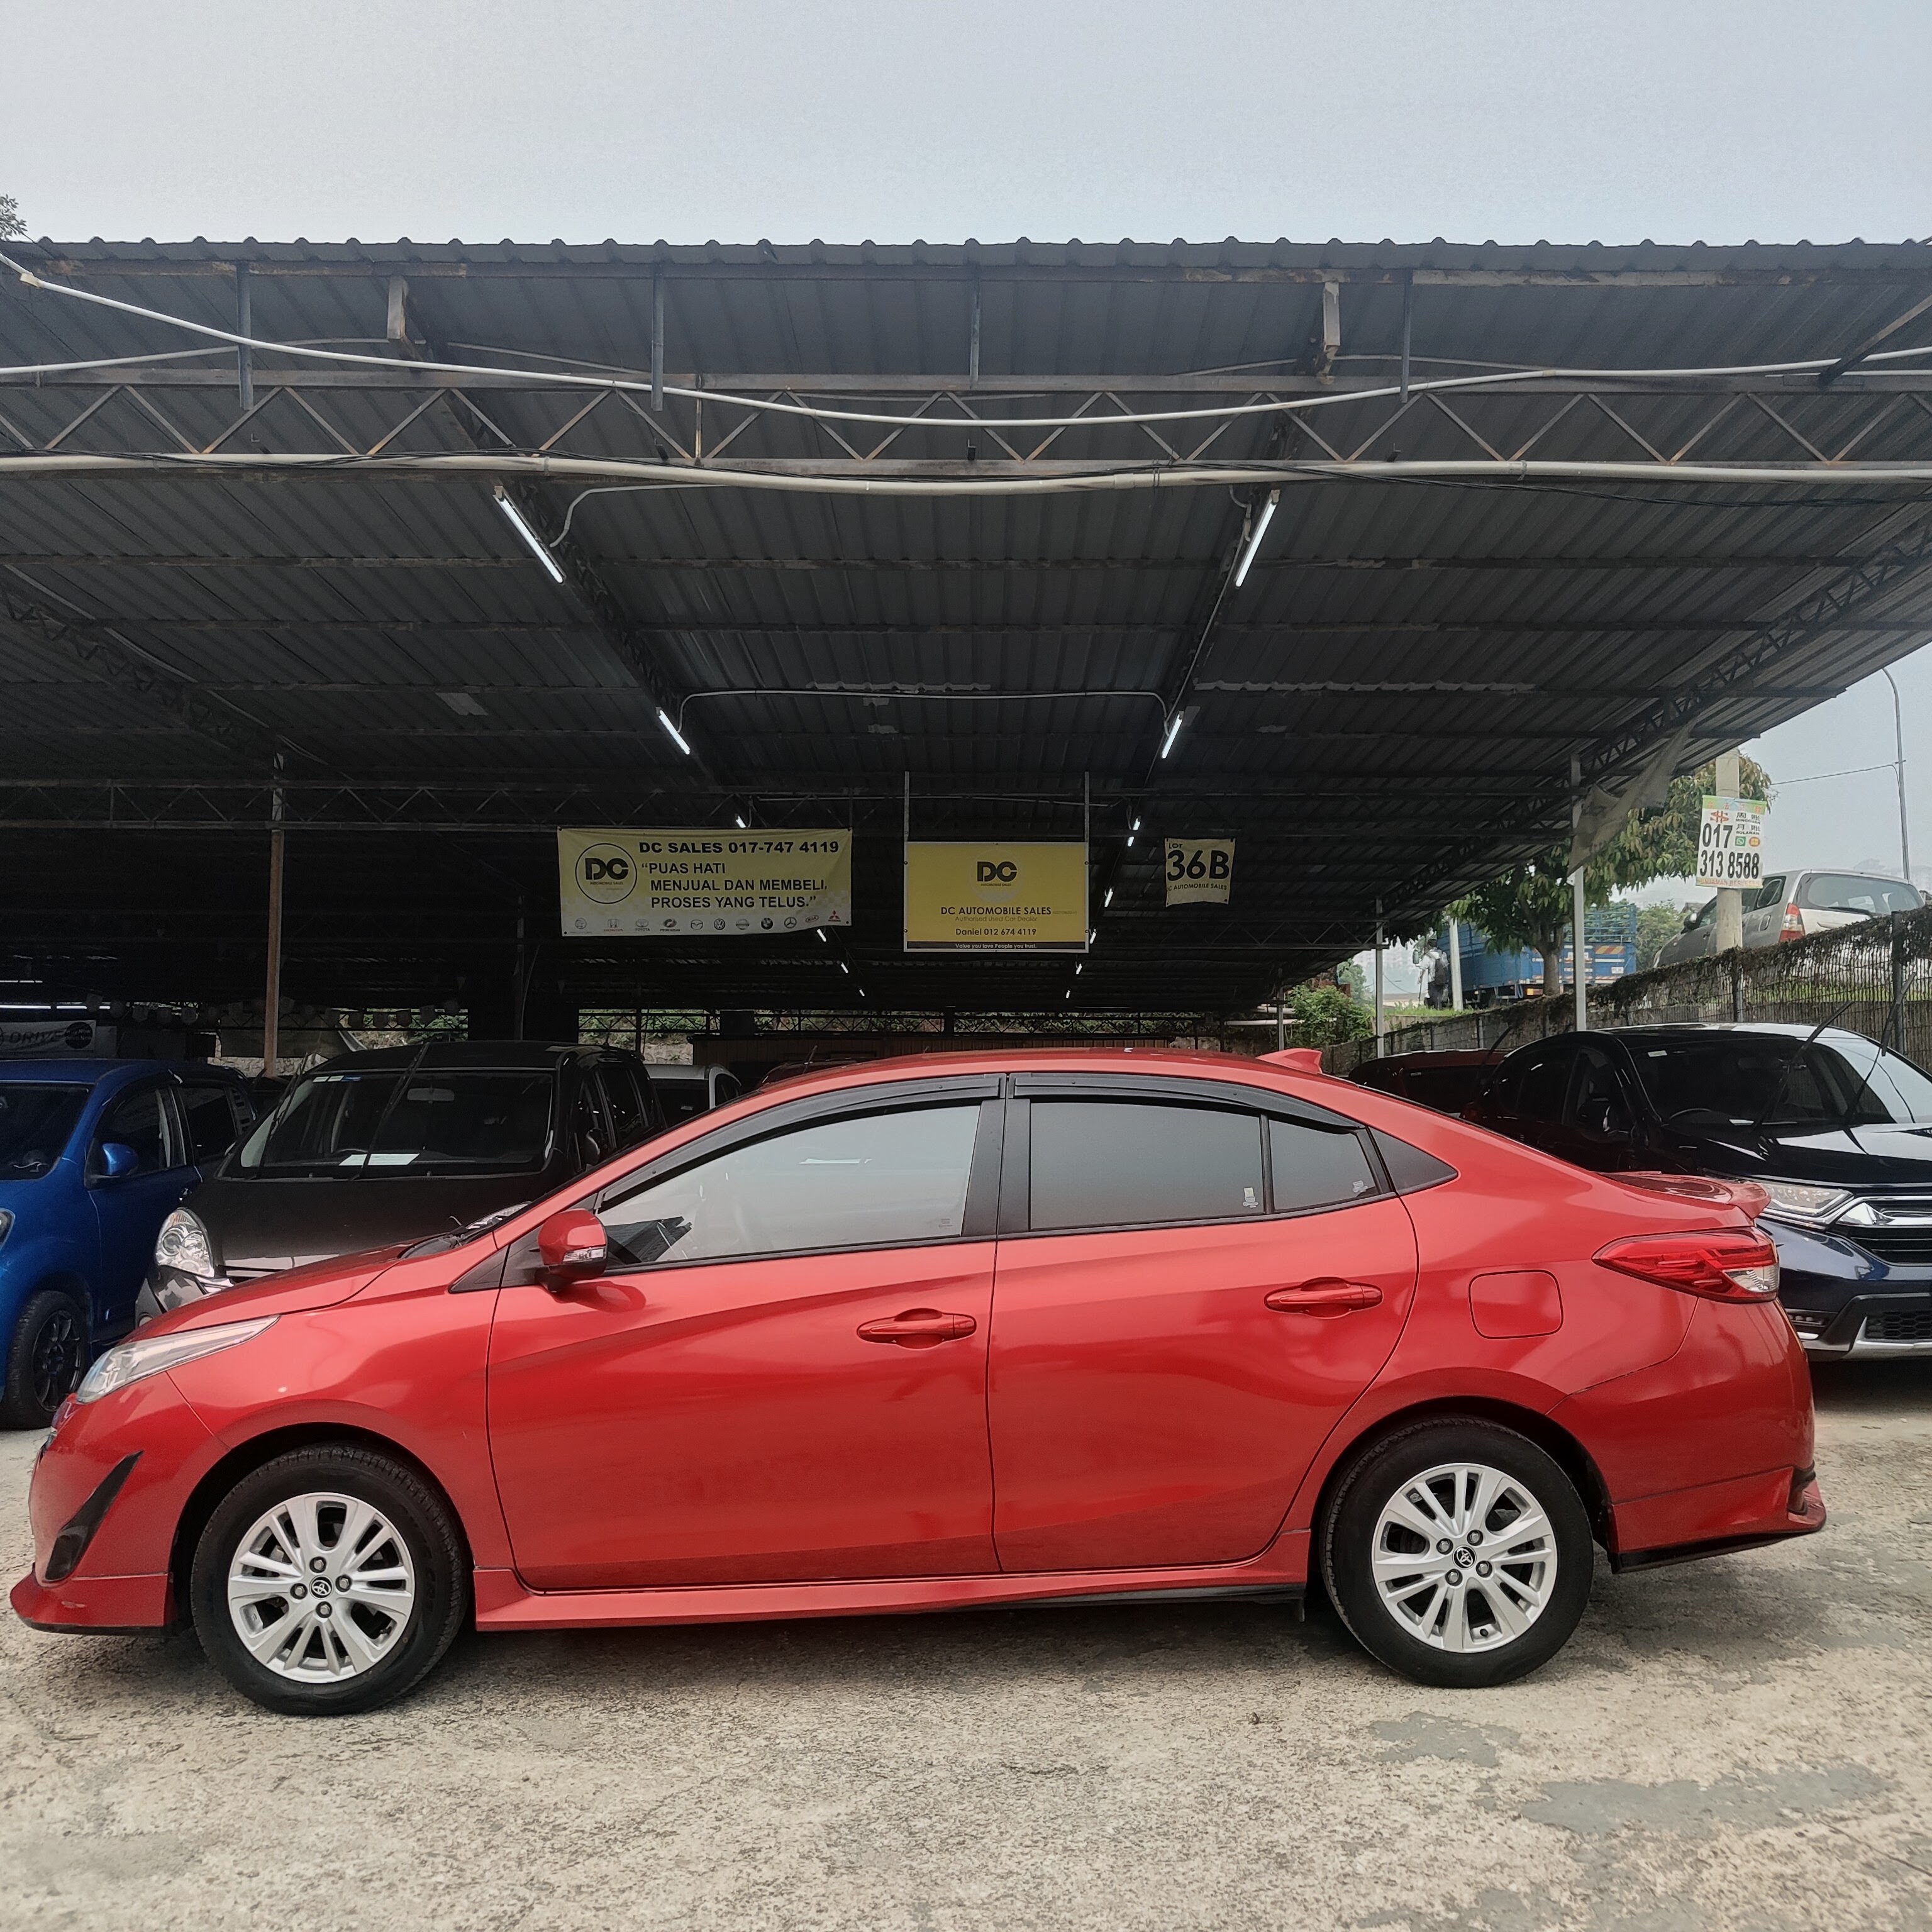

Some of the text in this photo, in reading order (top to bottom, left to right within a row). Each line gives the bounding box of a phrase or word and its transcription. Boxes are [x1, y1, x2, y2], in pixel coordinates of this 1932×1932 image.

[1702, 823, 1733, 848] 017
[640, 841, 839, 853] DC SALES 017-747 4119
[585, 857, 629, 880] DC
[694, 863, 725, 874] HATI
[1167, 850, 1230, 881] 36B
[1699, 849, 1760, 879] 313 8588
[977, 861, 1018, 882] DC
[650, 879, 828, 892] MENJUAL DAN MEMBELI,
[651, 896, 711, 908] PROSES
[715, 896, 755, 908] YANG
[941, 906, 955, 915] DC
[958, 906, 1021, 915] AUTOMOBILE
[1024, 906, 1052, 915] SALES
[956, 928, 1036, 936] Daniel 012 674 4119
